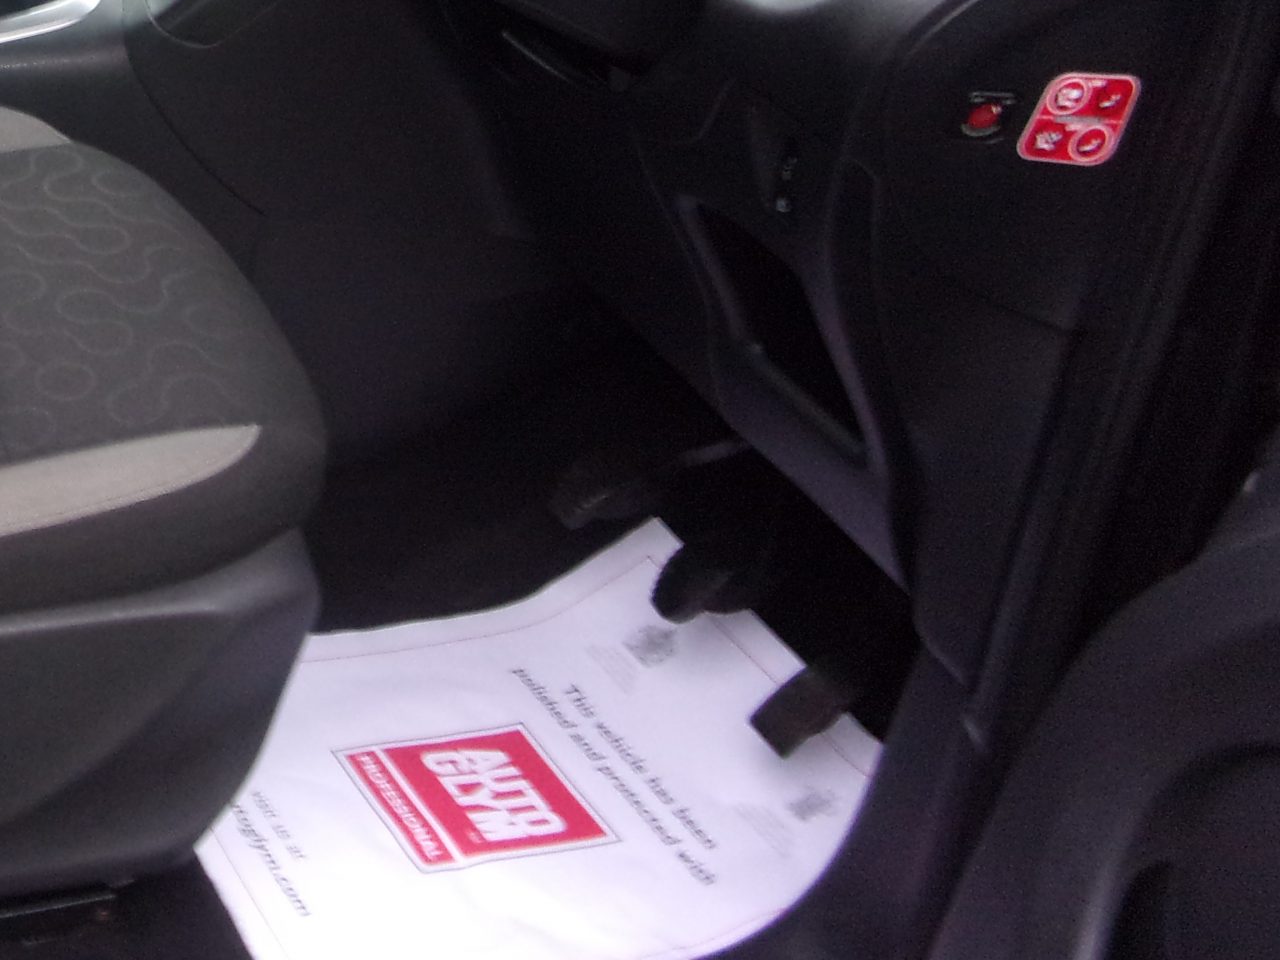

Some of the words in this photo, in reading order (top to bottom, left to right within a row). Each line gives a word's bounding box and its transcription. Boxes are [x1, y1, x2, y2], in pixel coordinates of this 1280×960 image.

[355, 754, 442, 860] PROFESSIONAL
[421, 751, 528, 841] GLYM
[457, 749, 568, 837] AUTO
[509, 668, 578, 729] polished
[570, 733, 607, 762] and
[595, 766, 683, 846] protected
[677, 850, 717, 886] with
[563, 684, 596, 719] This
[596, 722, 647, 774] vehicle
[647, 777, 675, 806] has
[673, 808, 717, 849] been
